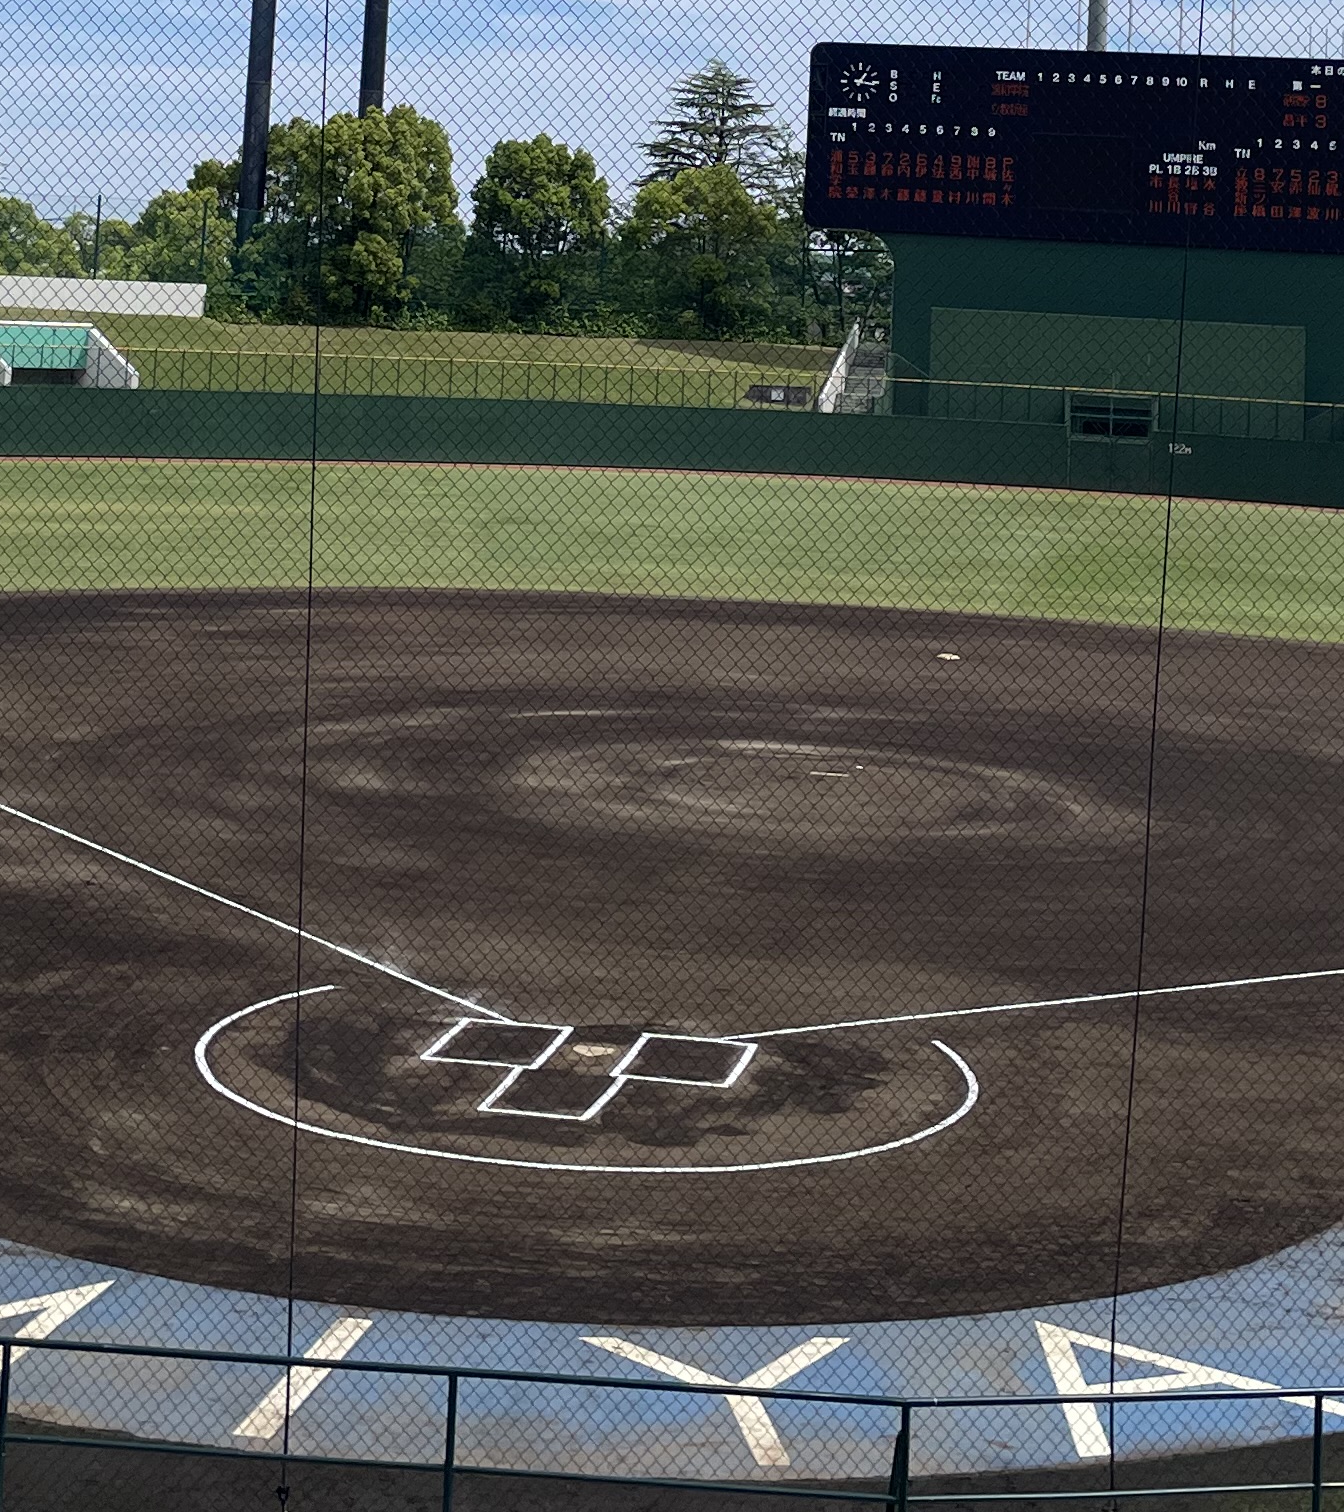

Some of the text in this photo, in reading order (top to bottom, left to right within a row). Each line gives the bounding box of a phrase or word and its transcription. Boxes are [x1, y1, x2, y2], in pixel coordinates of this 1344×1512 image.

[891, 70, 897, 78] B
[934, 72, 941, 80] H
[996, 71, 1255, 89] TEAM 1 2 3 4 5 6 7 8 9 10 R H E
[890, 81, 897, 90] S
[933, 83, 940, 92] E
[1316, 95, 1327, 108] 8
[1315, 115, 1326, 128] 3
[852, 123, 995, 136] 1 2 3 4 5 6 7 8 9
[830, 133, 845, 141] TN
[1199, 141, 1215, 150] Km
[1258, 139, 1262, 147] 1
[1275, 139, 1282, 148] 2
[1293, 140, 1300, 149] 3
[1311, 141, 1318, 149] 4
[1330, 141, 1336, 150] 5
[1235, 149, 1250, 158] TN
[1163, 153, 1204, 164] UMPIRE
[1149, 164, 1163, 173] PL
[1167, 165, 1181, 174] 1B
